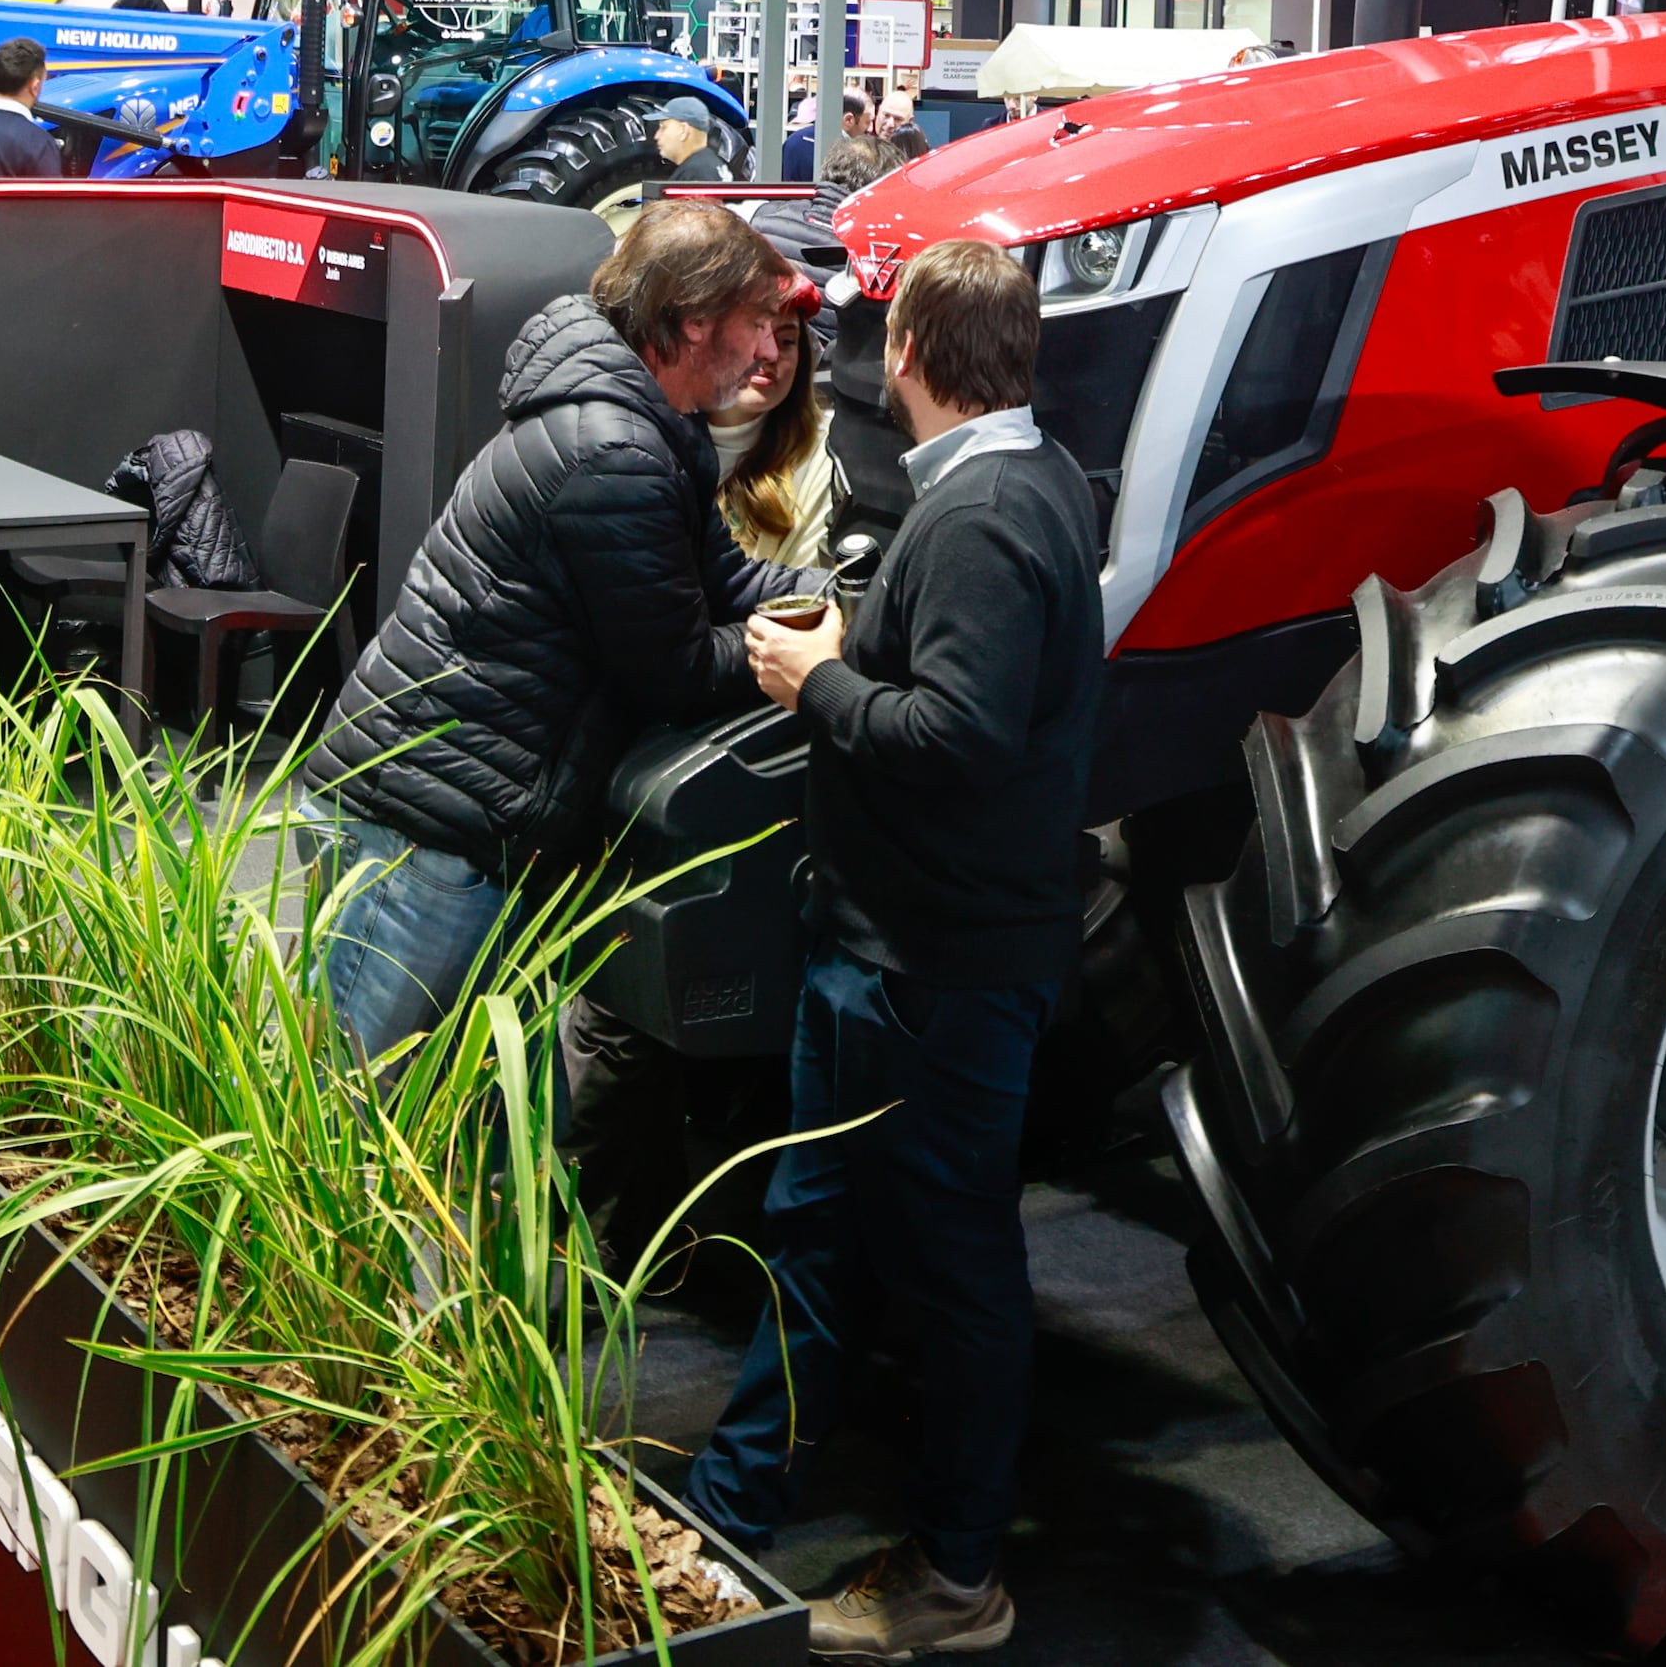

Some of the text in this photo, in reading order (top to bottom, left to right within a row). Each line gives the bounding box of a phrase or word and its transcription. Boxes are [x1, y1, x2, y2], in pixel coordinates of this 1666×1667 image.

[56, 29, 177, 51] NEW HOLLAND
[1500, 120, 1659, 189] MASSEY
[227, 230, 305, 265] AGRODIRECTO S.A.
[326, 249, 365, 270] BUENOS AIRES
